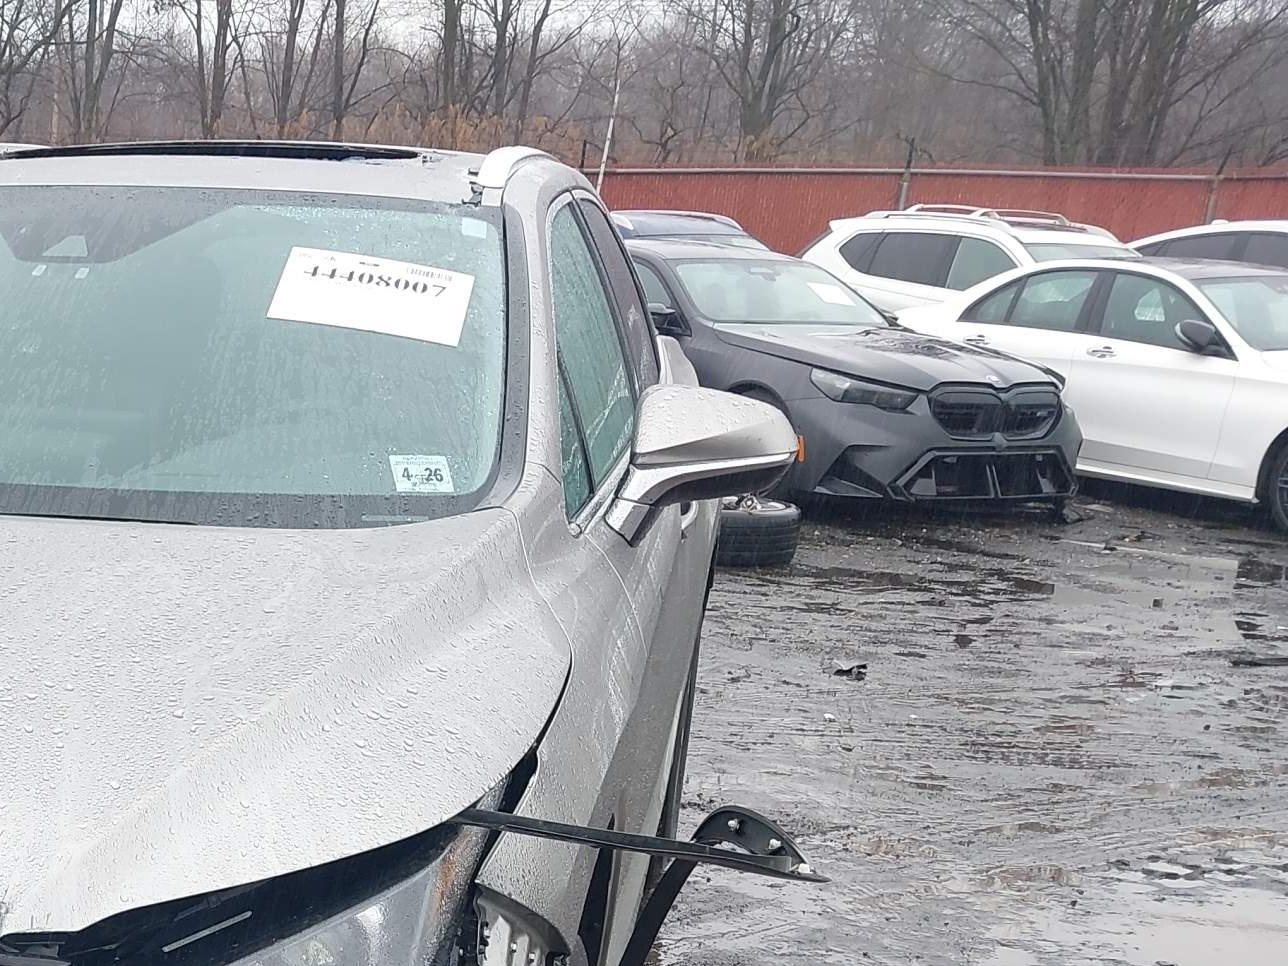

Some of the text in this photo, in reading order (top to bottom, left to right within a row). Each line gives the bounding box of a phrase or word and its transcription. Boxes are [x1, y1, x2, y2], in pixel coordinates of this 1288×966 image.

[303, 265, 447, 297] 44408007
[401, 466, 444, 483] 4 26
